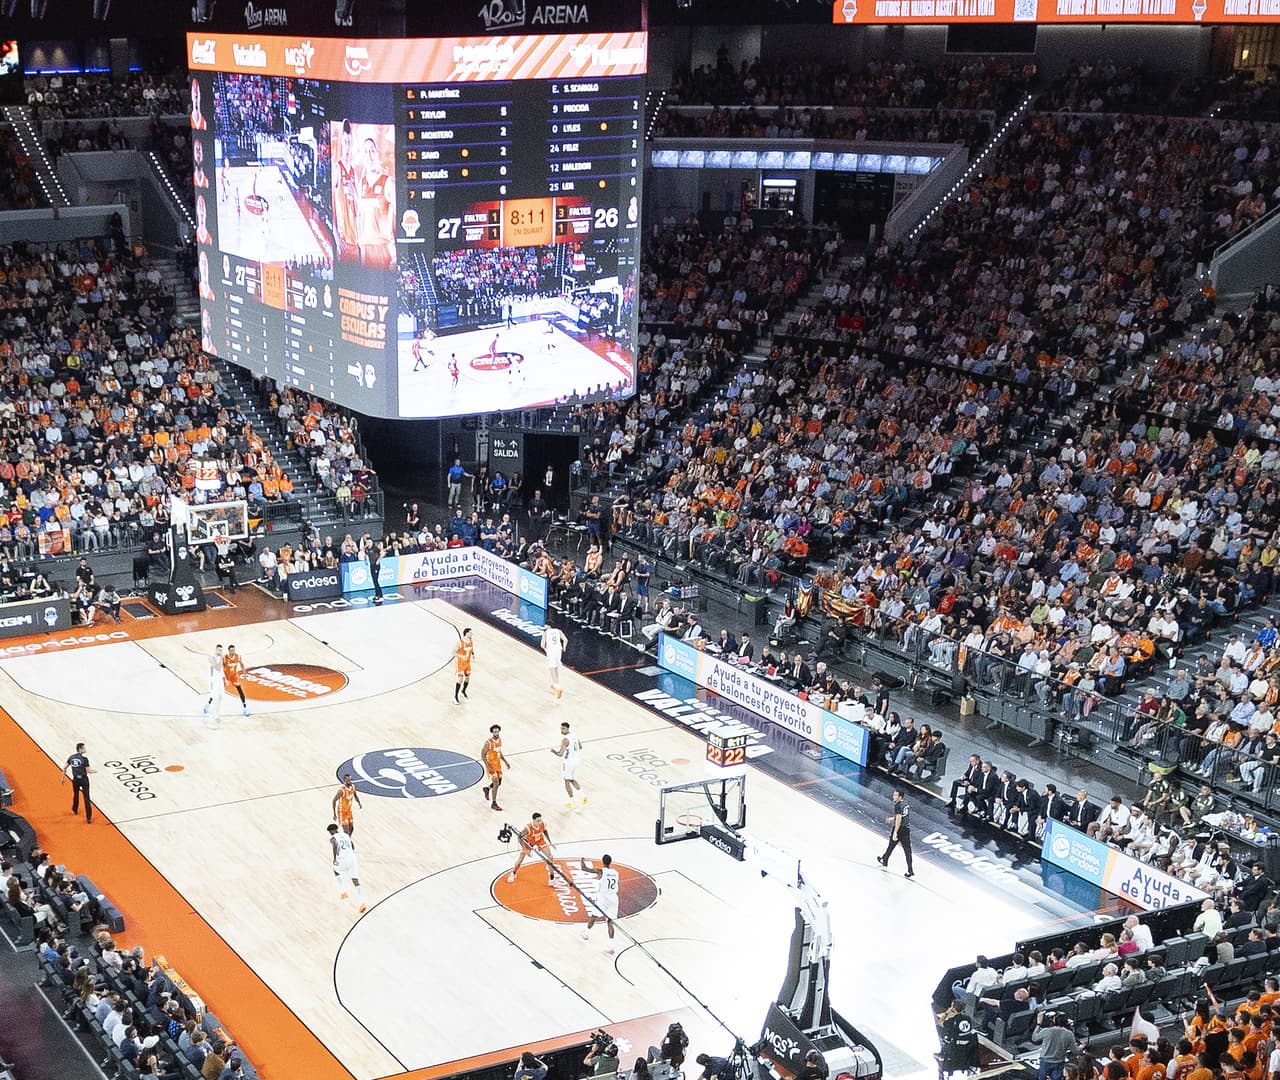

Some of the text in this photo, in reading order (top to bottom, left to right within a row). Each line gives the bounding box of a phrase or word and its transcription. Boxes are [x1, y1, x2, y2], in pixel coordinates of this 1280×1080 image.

[532, 5, 589, 24] ARENA
[420, 111, 446, 119] TAYLOR
[552, 105, 558, 114] 9
[500, 126, 507, 136] 2
[406, 151, 417, 160] 12
[500, 146, 507, 156] 2
[550, 144, 560, 153] 24
[500, 166, 506, 176] 0
[550, 164, 560, 172] 12
[549, 183, 560, 192] 25
[510, 208, 545, 226] 8:11
[558, 208, 565, 218] 3
[594, 208, 619, 229] 26
[438, 218, 461, 240] 27
[235, 265, 246, 286] 27
[304, 285, 318, 308] 26
[339, 297, 389, 321] CAMPUS Y
[493, 449, 519, 458] SALIDA
[421, 551, 510, 576] Ayuda a tu proyecto
[291, 574, 338, 590] endesa
[413, 568, 428, 579] de
[432, 561, 488, 577] baloncesto
[488, 569, 514, 589] favorito
[714, 664, 807, 719] Ayuda a tu proyecto
[706, 676, 812, 735] de baloncesto favorito
[628, 748, 672, 768] liga
[708, 744, 722, 763] 22
[724, 748, 744, 766] 22
[129, 754, 162, 775] liga
[384, 749, 458, 794] PULEVA
[104, 760, 158, 800] endesa
[710, 835, 732, 854] endesa
[922, 832, 1020, 883] Vitaldin
[1070, 856, 1100, 876] endesa
[1121, 880, 1140, 898] de
[1132, 867, 1180, 901] Ayuda
[764, 1027, 787, 1052] MGS
